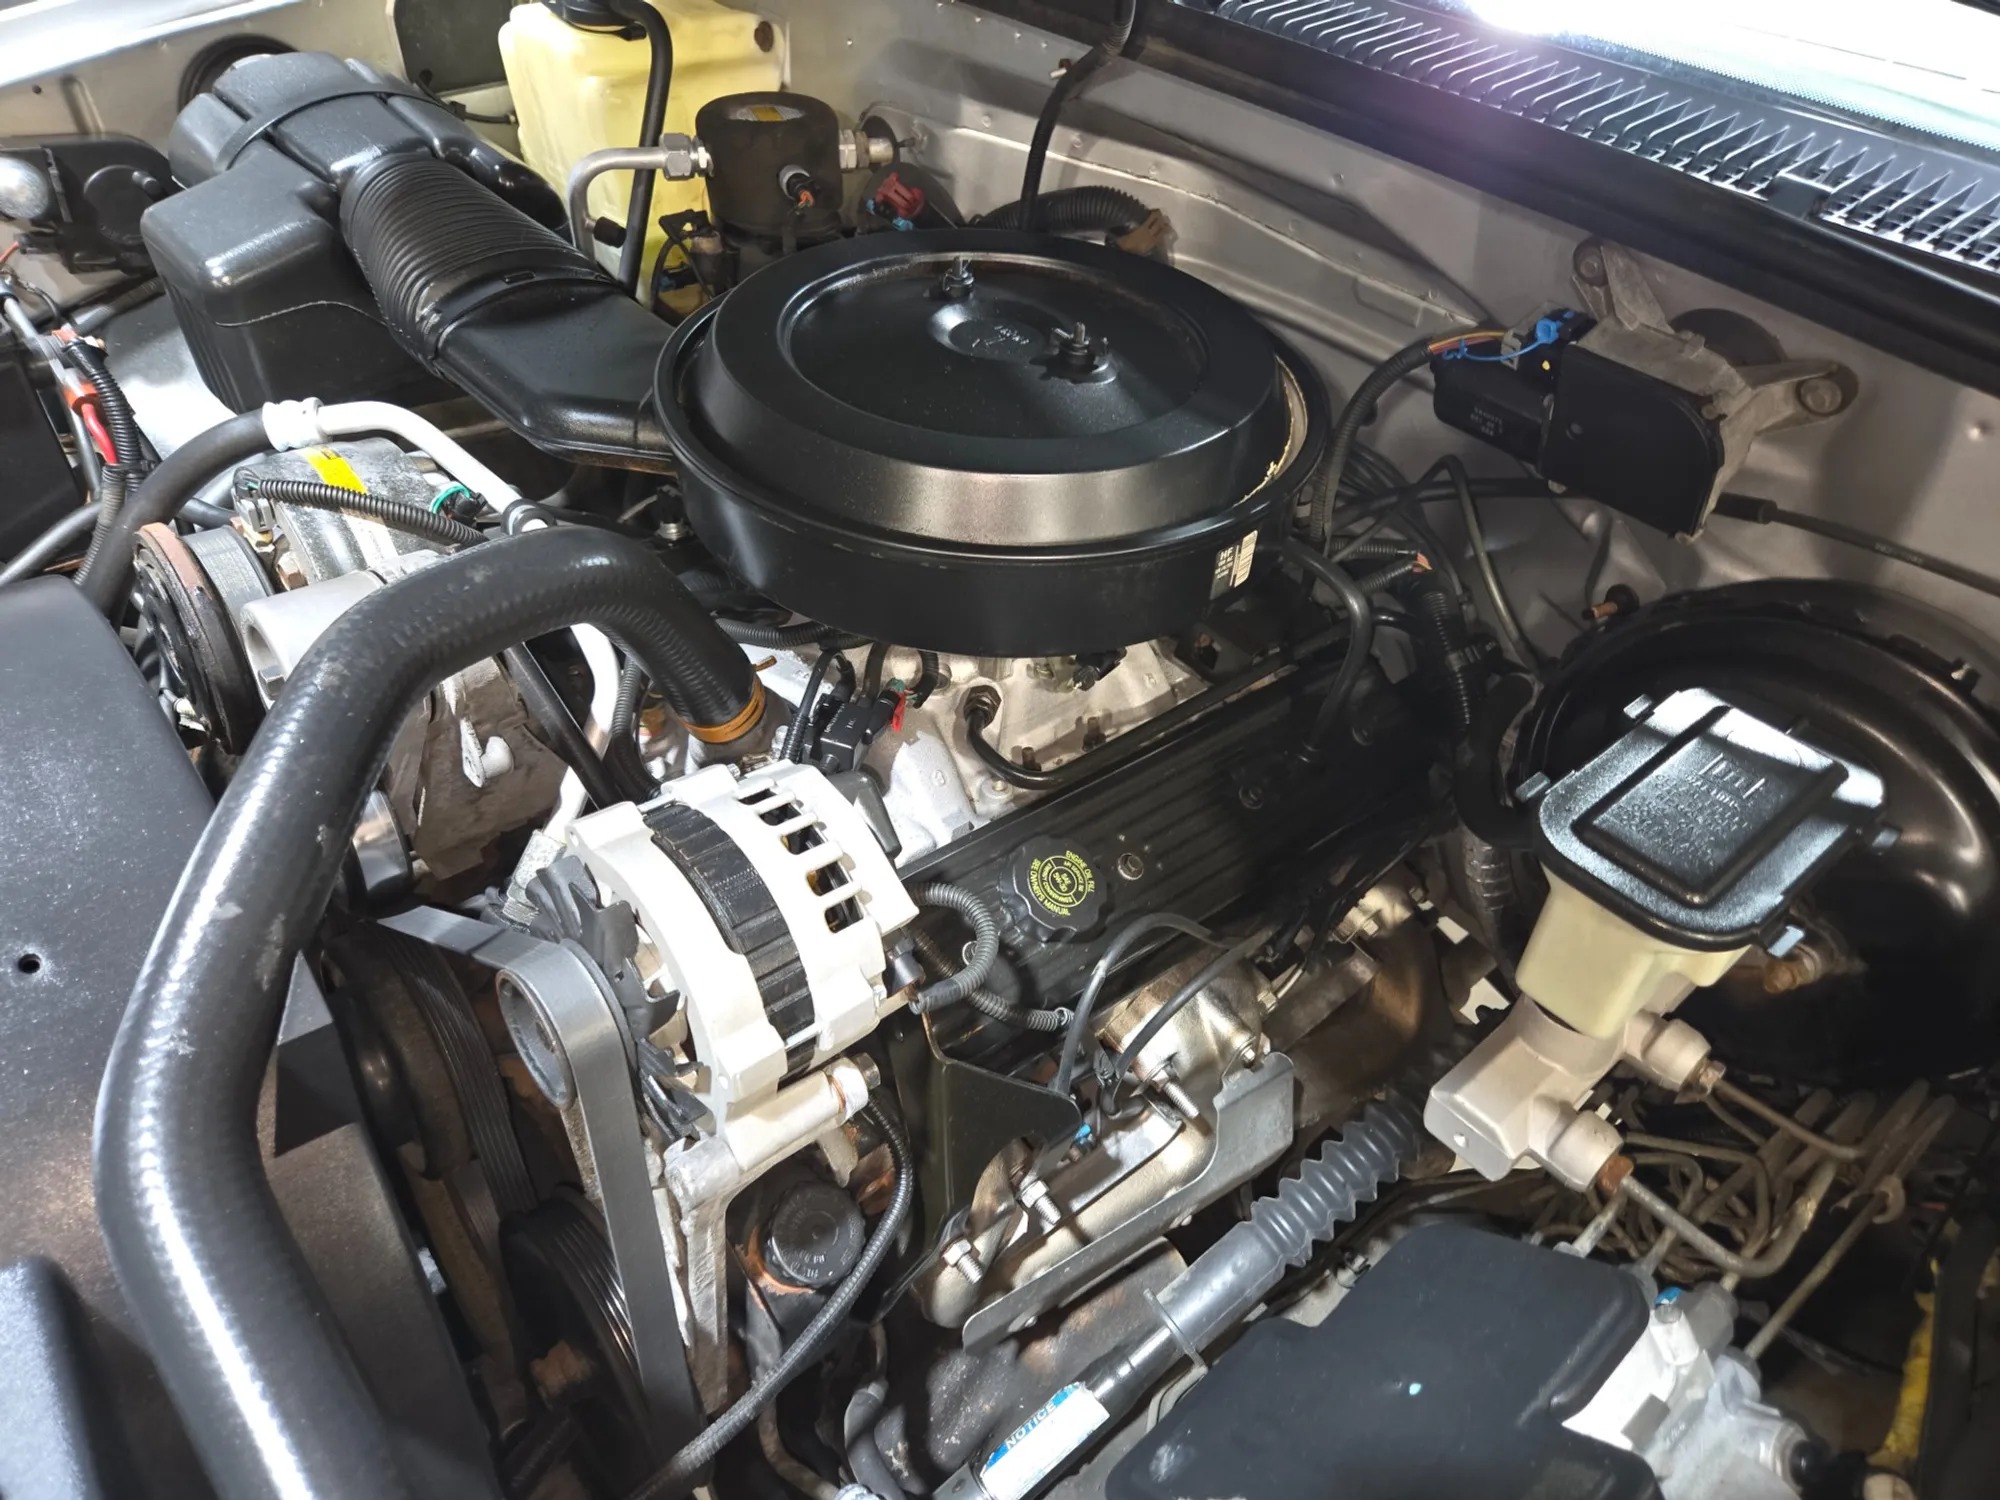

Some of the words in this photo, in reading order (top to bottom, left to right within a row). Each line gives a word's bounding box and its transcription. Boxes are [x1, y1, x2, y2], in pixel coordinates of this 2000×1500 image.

[1032, 859, 1041, 870] SEE
[1066, 851, 1088, 870] ENGINE
[1085, 869, 1093, 879] OIL
[1031, 871, 1045, 901] OWNER'S
[1053, 872, 1068, 892] 5W-30
[1062, 873, 1072, 885] SAE
[1043, 900, 1071, 915] MANUAL
[1006, 1401, 1057, 1449] NOTICE
